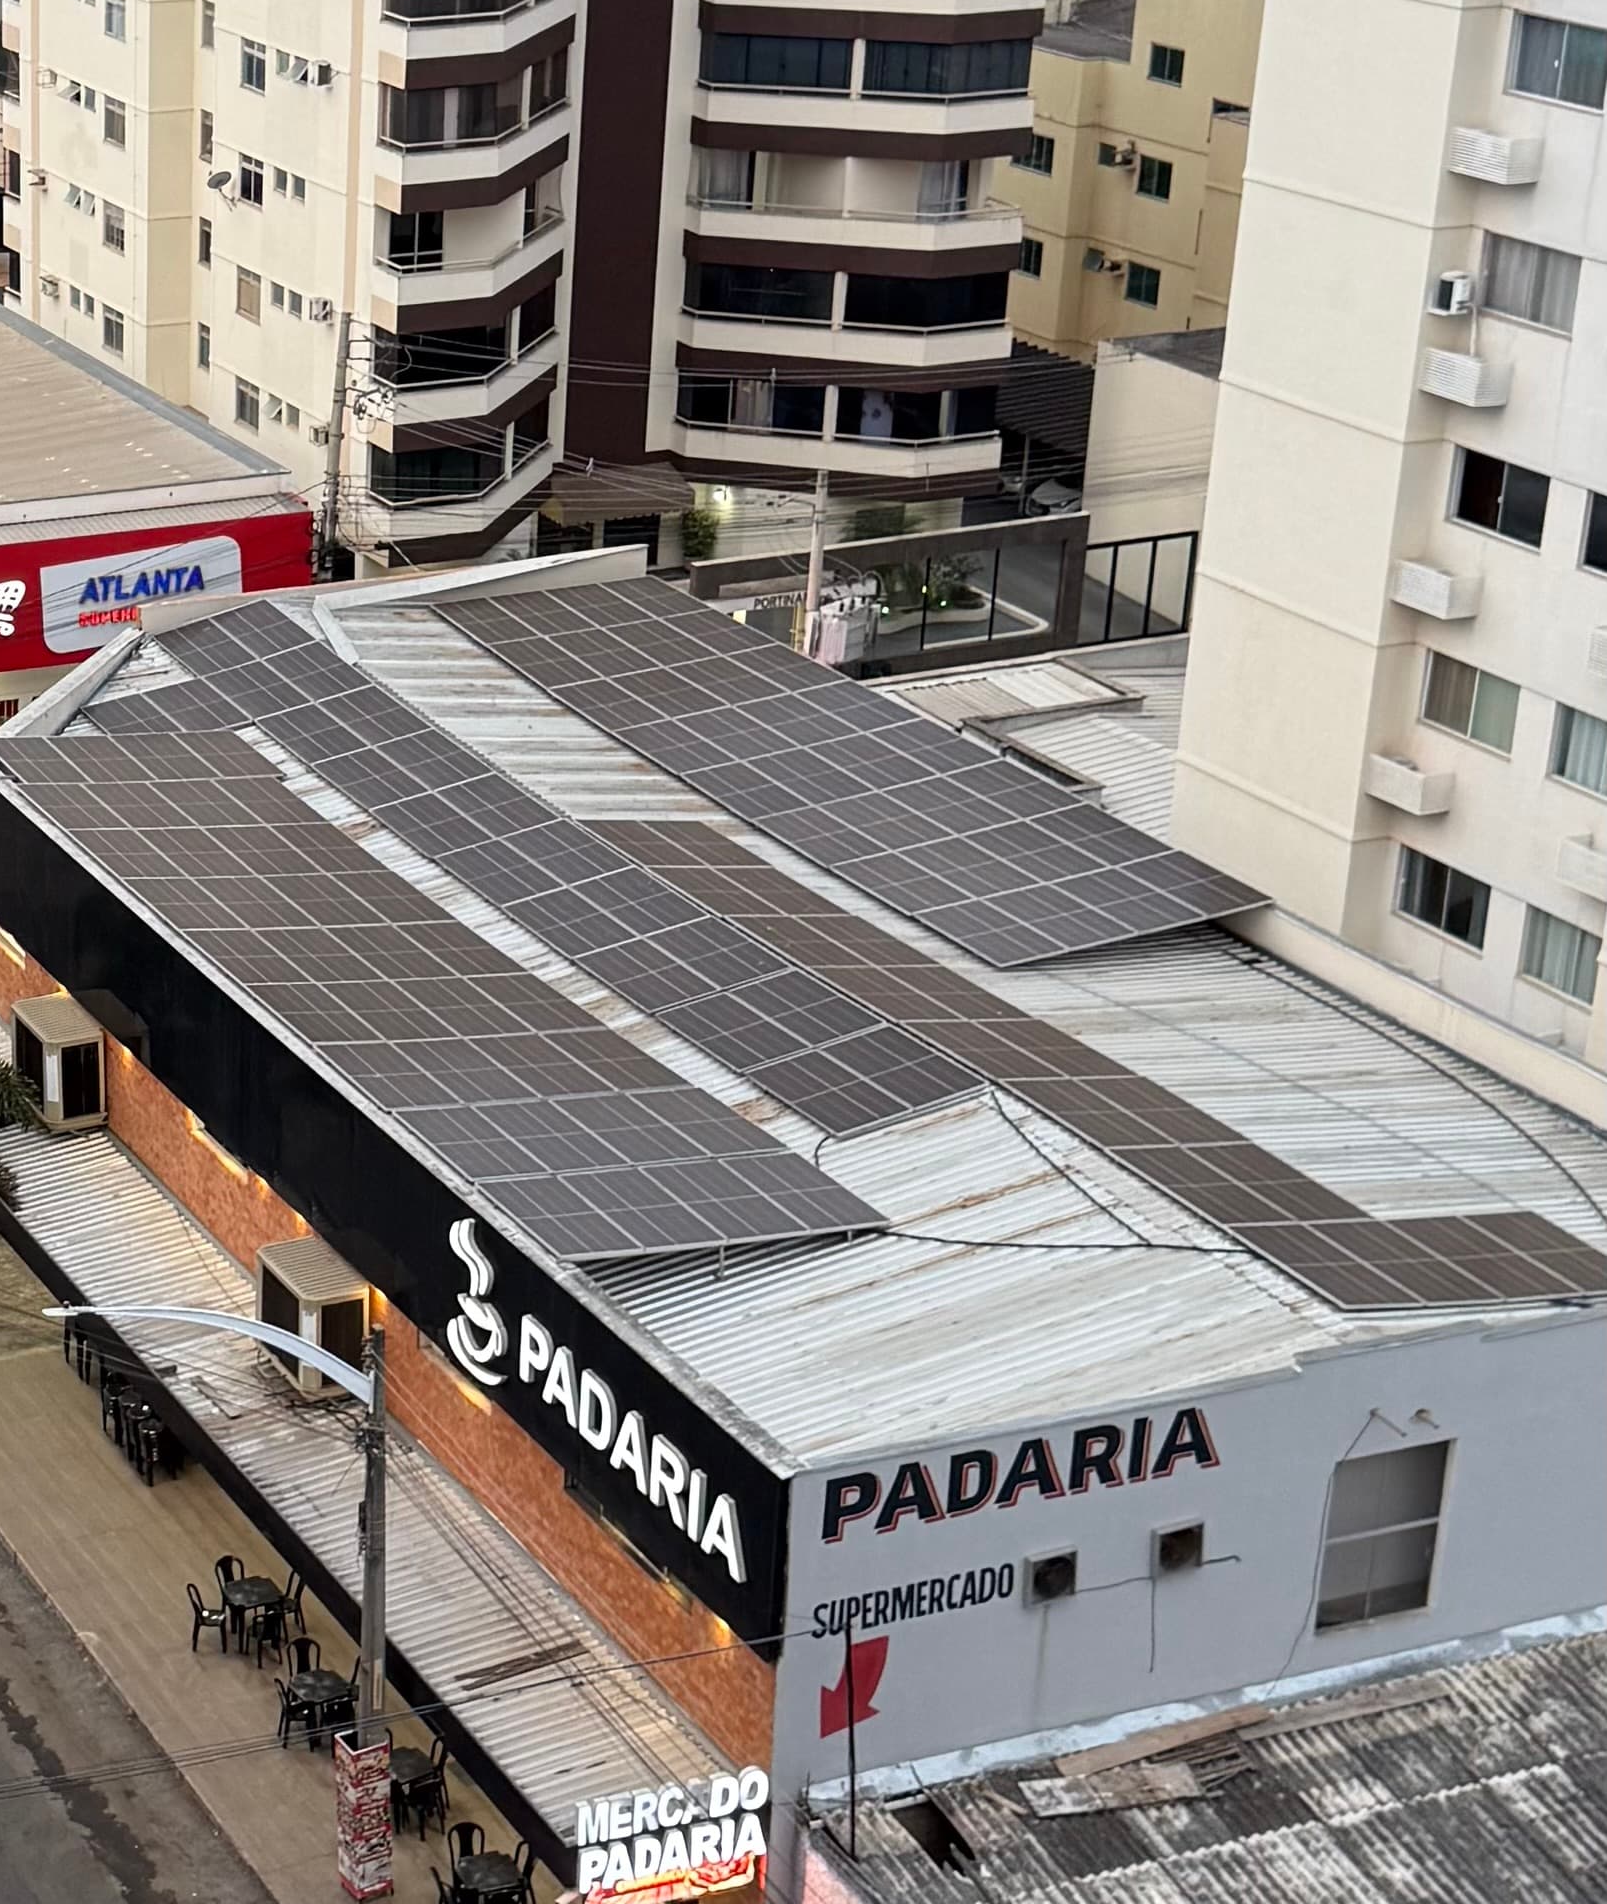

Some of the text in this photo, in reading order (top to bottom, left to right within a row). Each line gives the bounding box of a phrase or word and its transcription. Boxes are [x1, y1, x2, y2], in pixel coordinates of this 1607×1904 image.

[79, 564, 206, 605] ATLANTA
[753, 591, 807, 609] PORTINA
[519, 1313, 748, 1584] PADARIA
[821, 1406, 1221, 1545] PADARIA
[811, 1562, 1016, 1639] SUPERMERCADO
[578, 1812, 767, 1895] PADARIA
